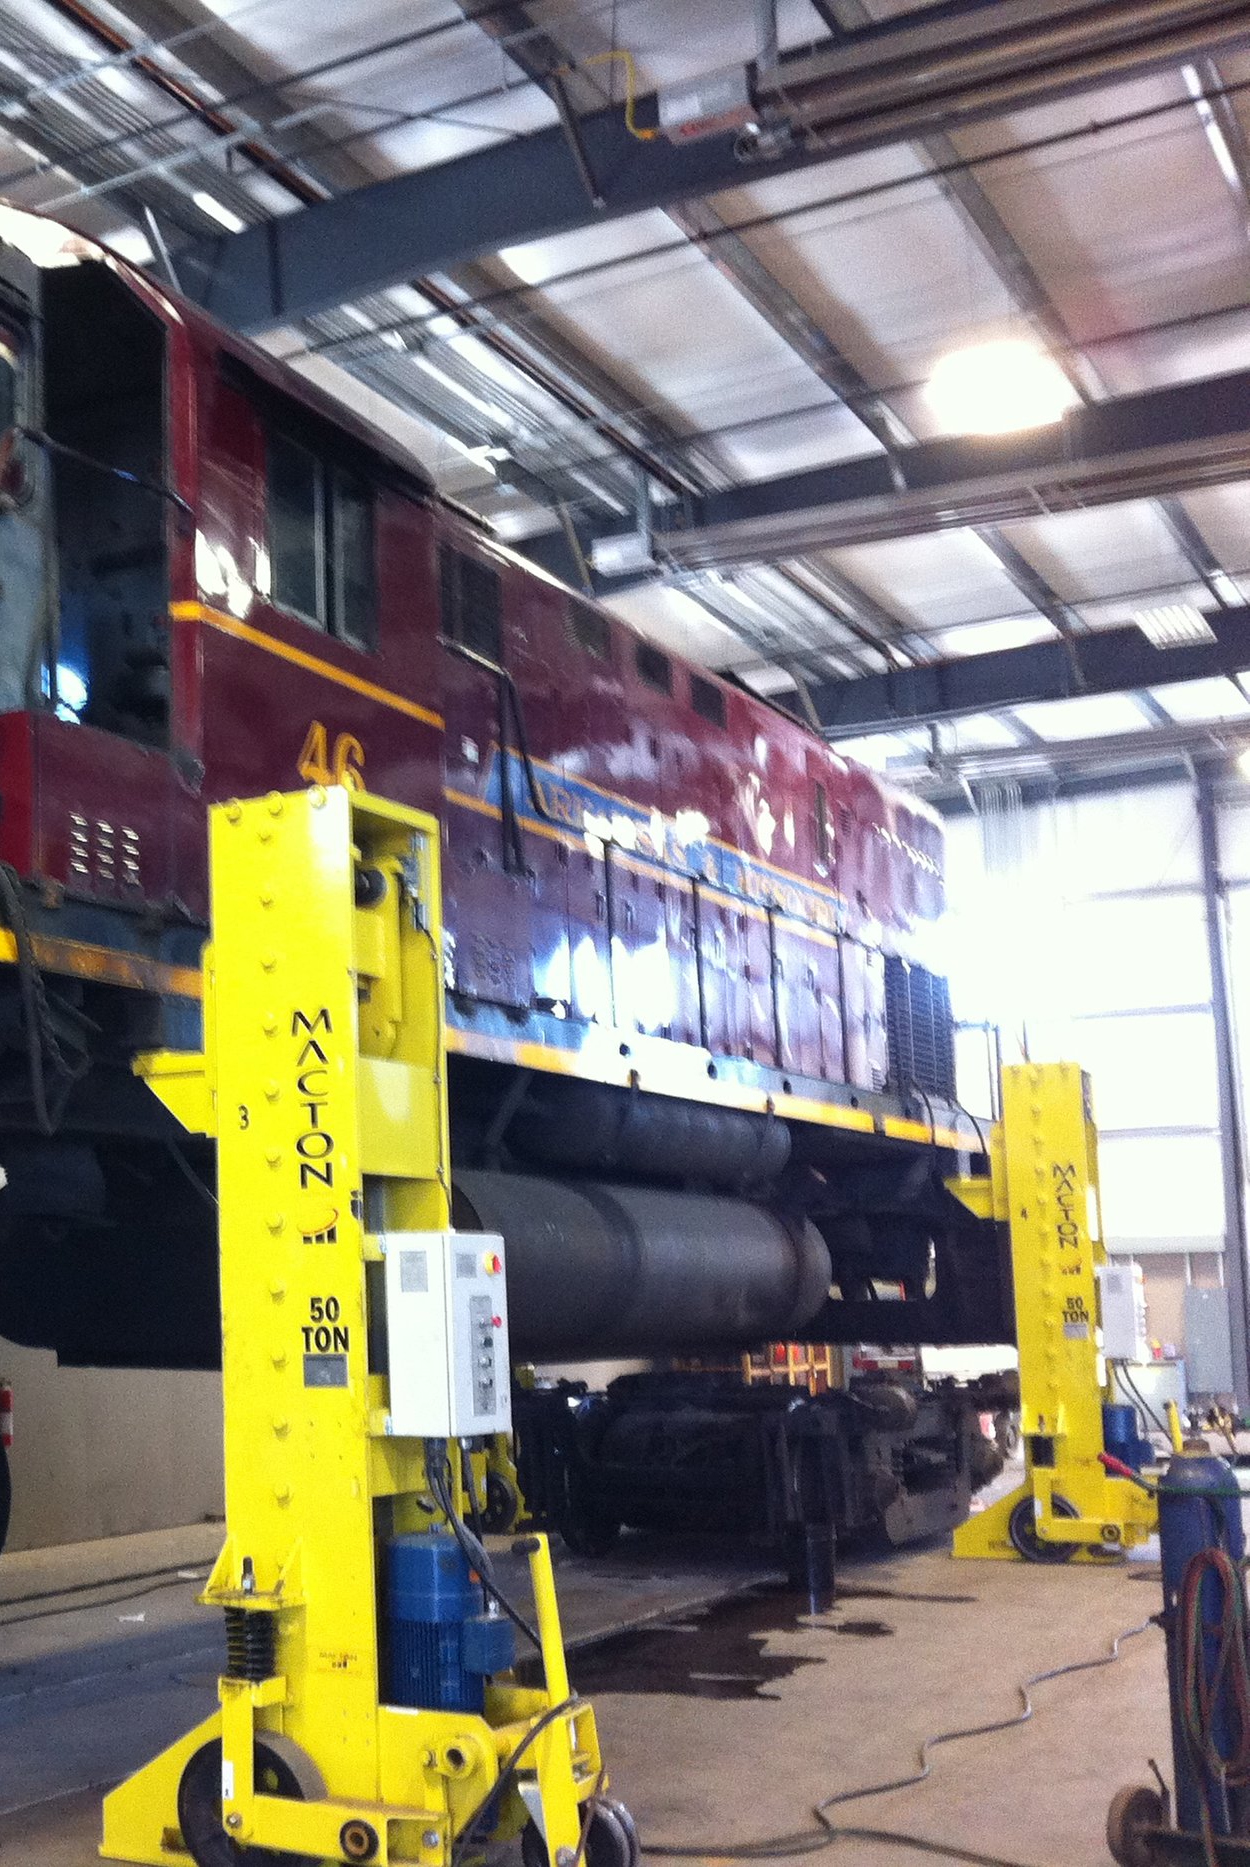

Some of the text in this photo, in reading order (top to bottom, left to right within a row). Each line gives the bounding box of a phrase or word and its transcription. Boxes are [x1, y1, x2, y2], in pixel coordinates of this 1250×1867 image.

[298, 720, 366, 791] 46
[291, 1008, 334, 1189] MACTON
[238, 1105, 249, 1130] 3
[1053, 1164, 1078, 1249] MACTON
[310, 1296, 340, 1323] 50
[1063, 1311, 1089, 1323] TON
[1066, 1298, 1084, 1311] 50
[301, 1326, 349, 1353] TON
